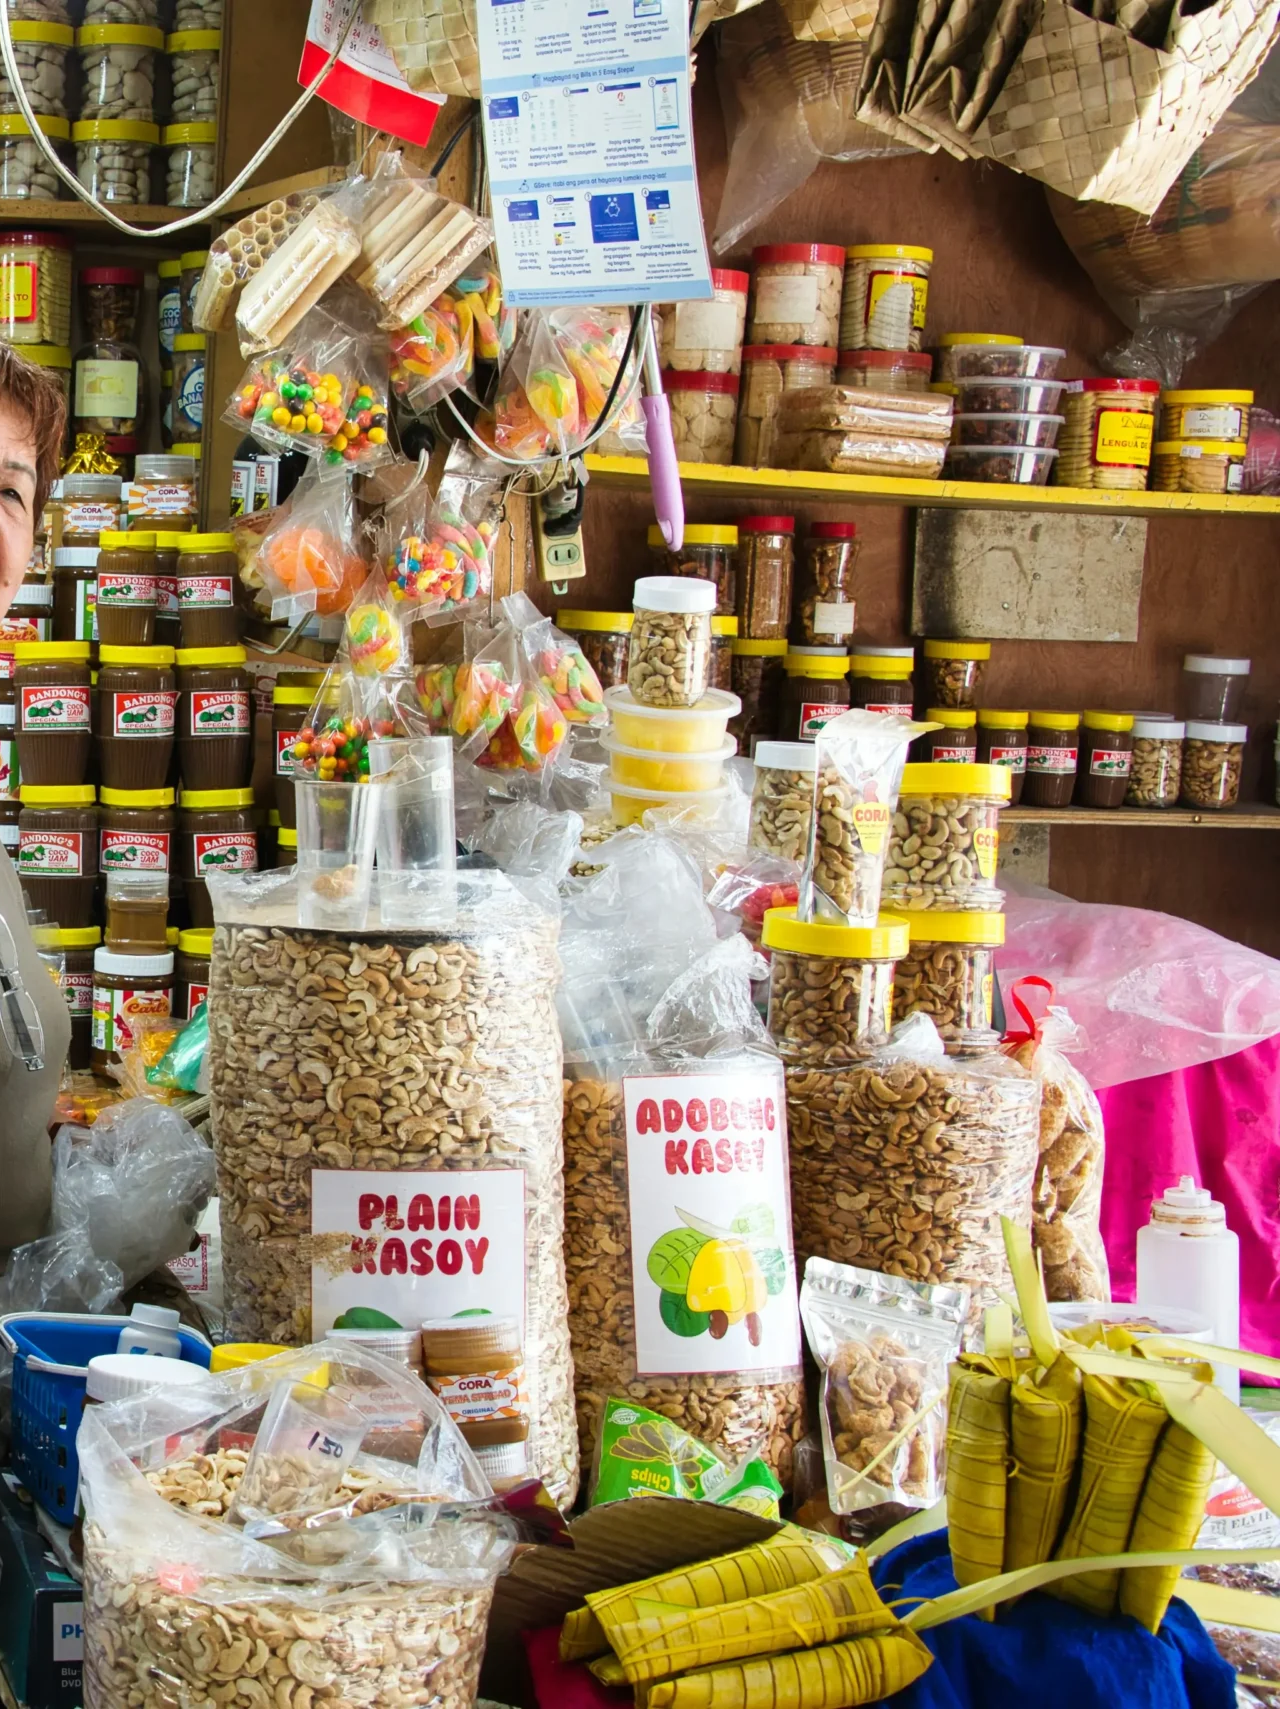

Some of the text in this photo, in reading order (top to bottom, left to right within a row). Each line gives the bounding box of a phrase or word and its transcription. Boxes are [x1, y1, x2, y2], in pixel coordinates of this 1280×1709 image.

[353, 29, 360, 38] 24
[369, 37, 379, 47] 25
[581, 70, 592, 79] Bills
[603, 68, 616, 78] Easy
[617, 66, 635, 75] Steps!
[163, 308, 180, 318] COC
[178, 394, 203, 409] BANA
[1102, 438, 1148, 450] LENGUA DE
[29, 689, 87, 702] BANDONG'S
[67, 709, 83, 717] JAM
[855, 809, 888, 822] CORA
[106, 835, 164, 848] BANDONG'S
[48, 855, 69, 863] JAM
[127, 1002, 168, 1013] Carl's
[635, 1097, 776, 1136] ADOBONG
[663, 1138, 766, 1176] KASOY
[358, 1193, 481, 1231] PLAIN
[351, 1236, 490, 1277] KASOY
[459, 1380, 492, 1391] CORA
[462, 1407, 495, 1415] ORIGINAL
[631, 1468, 671, 1491] Chips
[61, 1668, 81, 1676] Blu-
[61, 1680, 82, 1688] DVD
